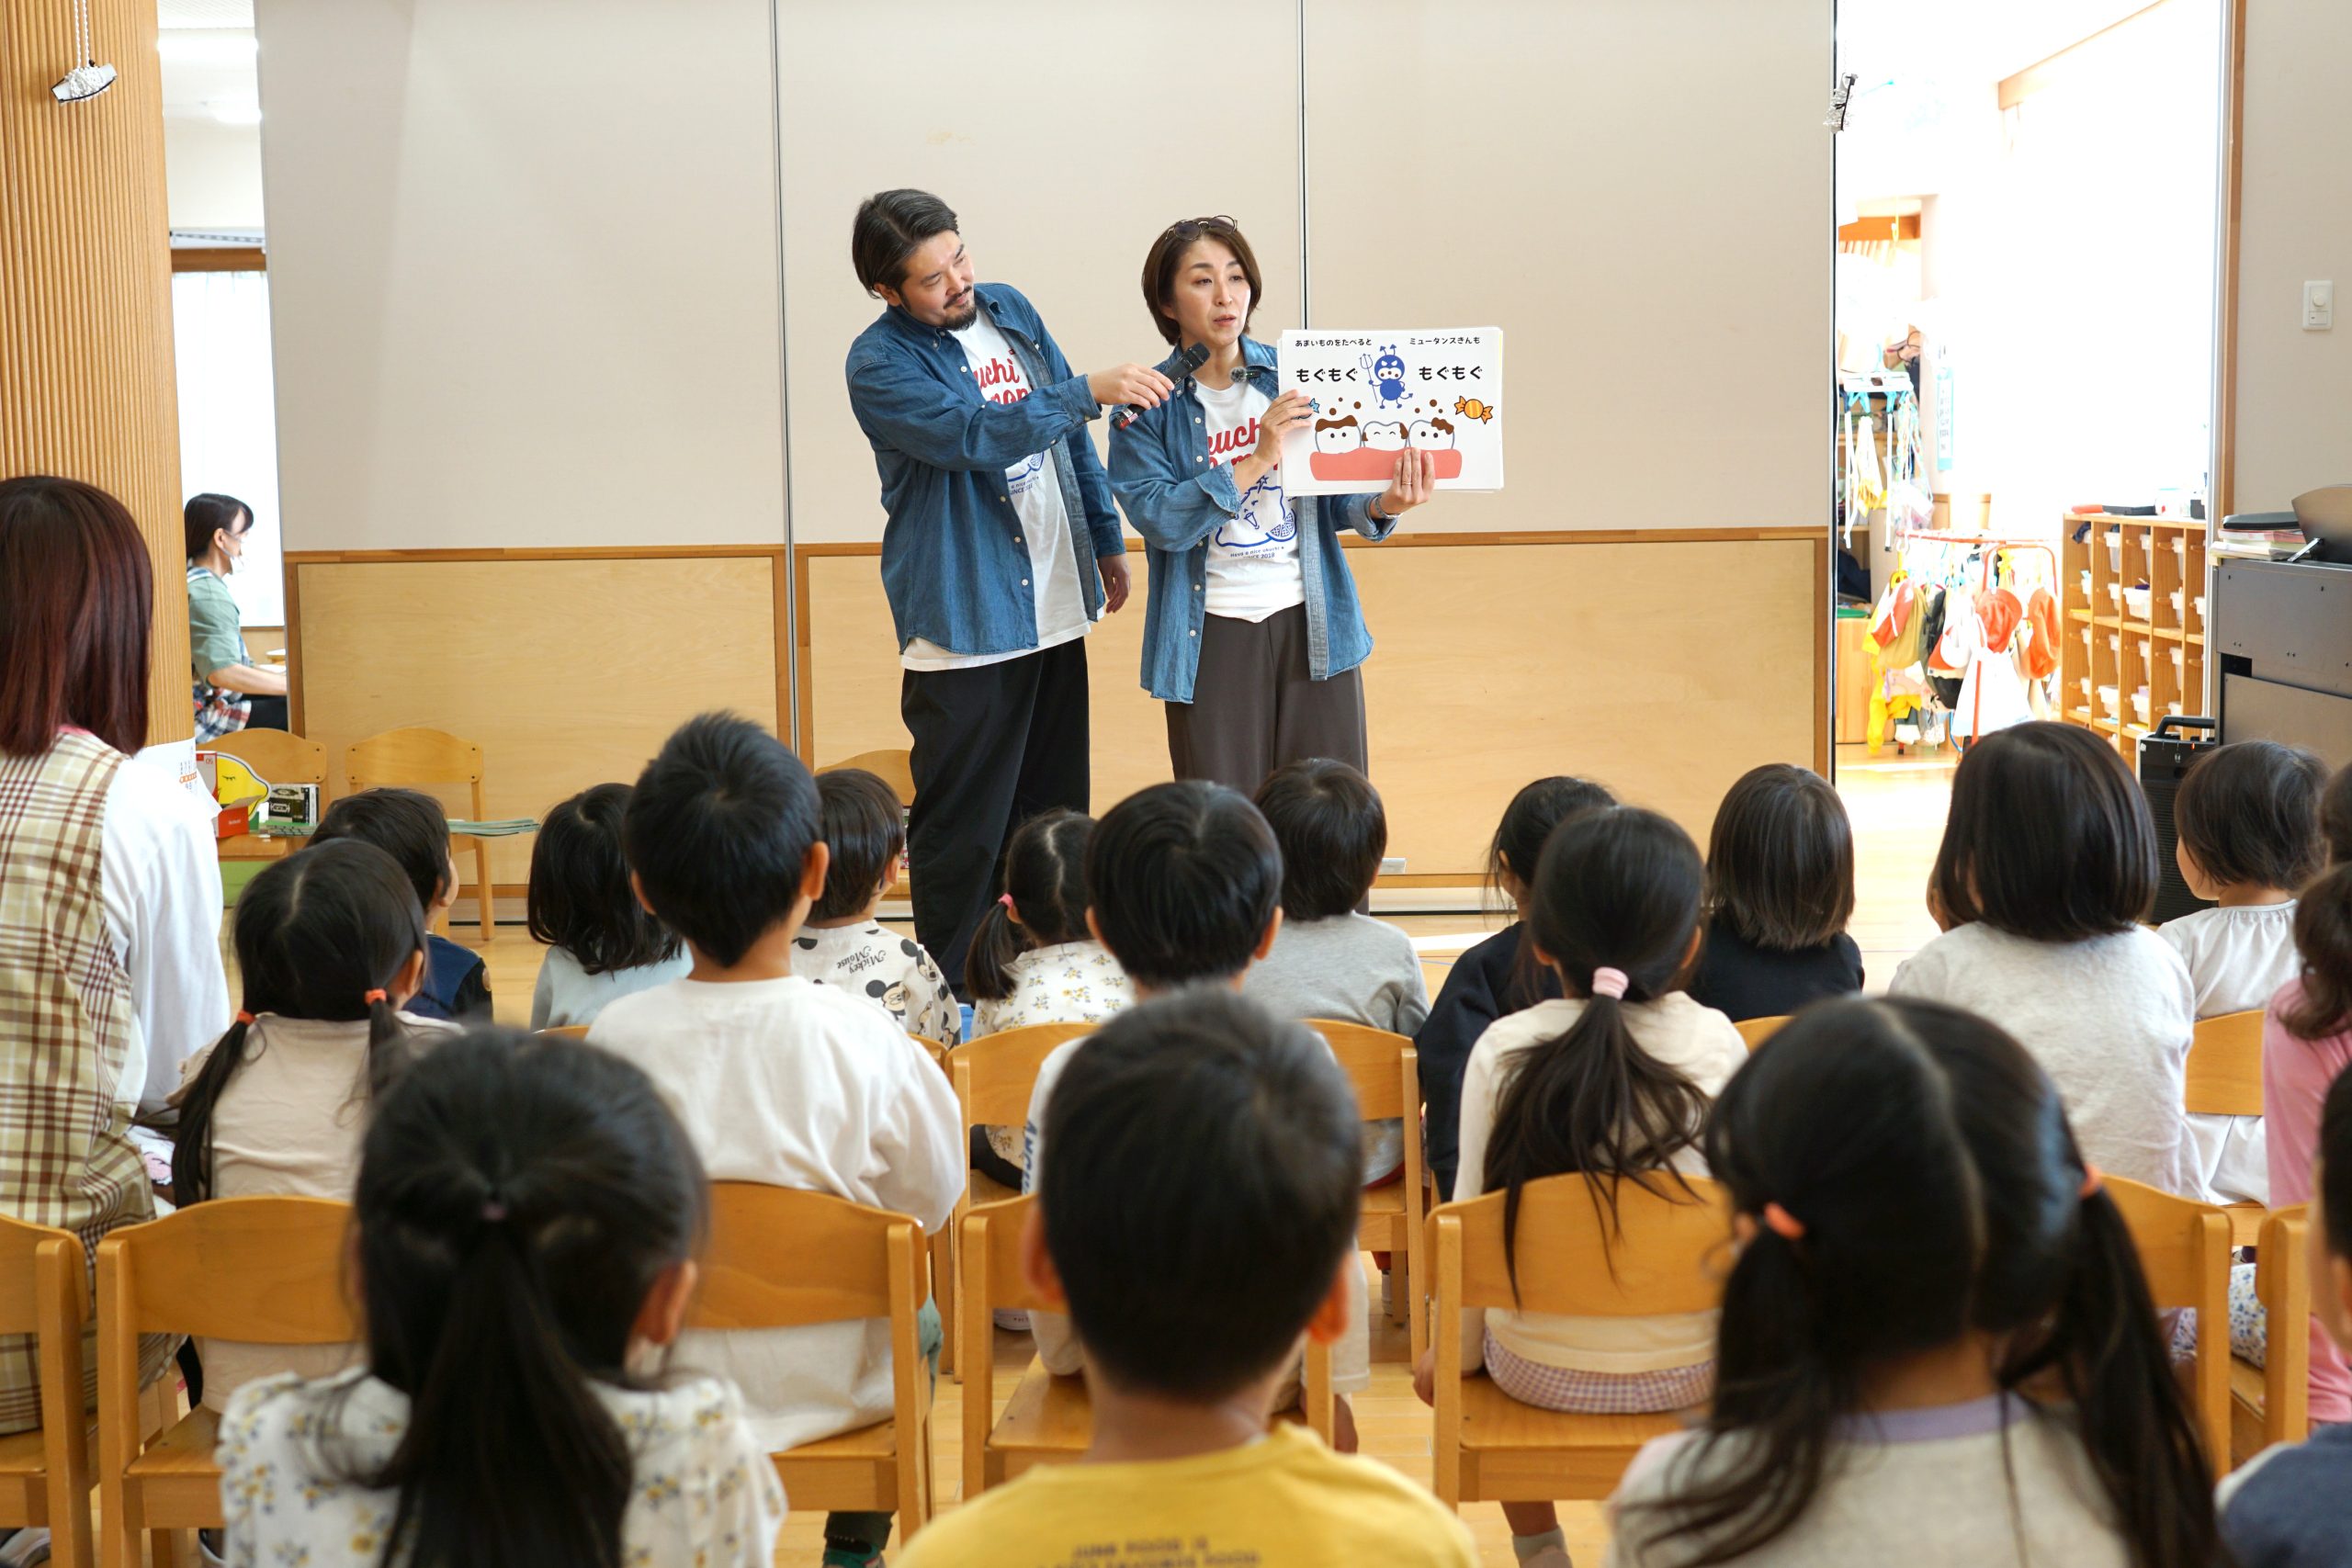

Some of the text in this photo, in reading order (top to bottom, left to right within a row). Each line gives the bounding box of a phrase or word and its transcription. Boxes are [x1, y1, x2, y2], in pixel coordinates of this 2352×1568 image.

[1295, 338, 1373, 347] あまいものをたべると
[1295, 367, 1358, 383] もぐもぐ
[1419, 365, 1484, 381] もぐもぐ
[836, 945, 872, 969] Mouse
[849, 949, 887, 975] Mickey
